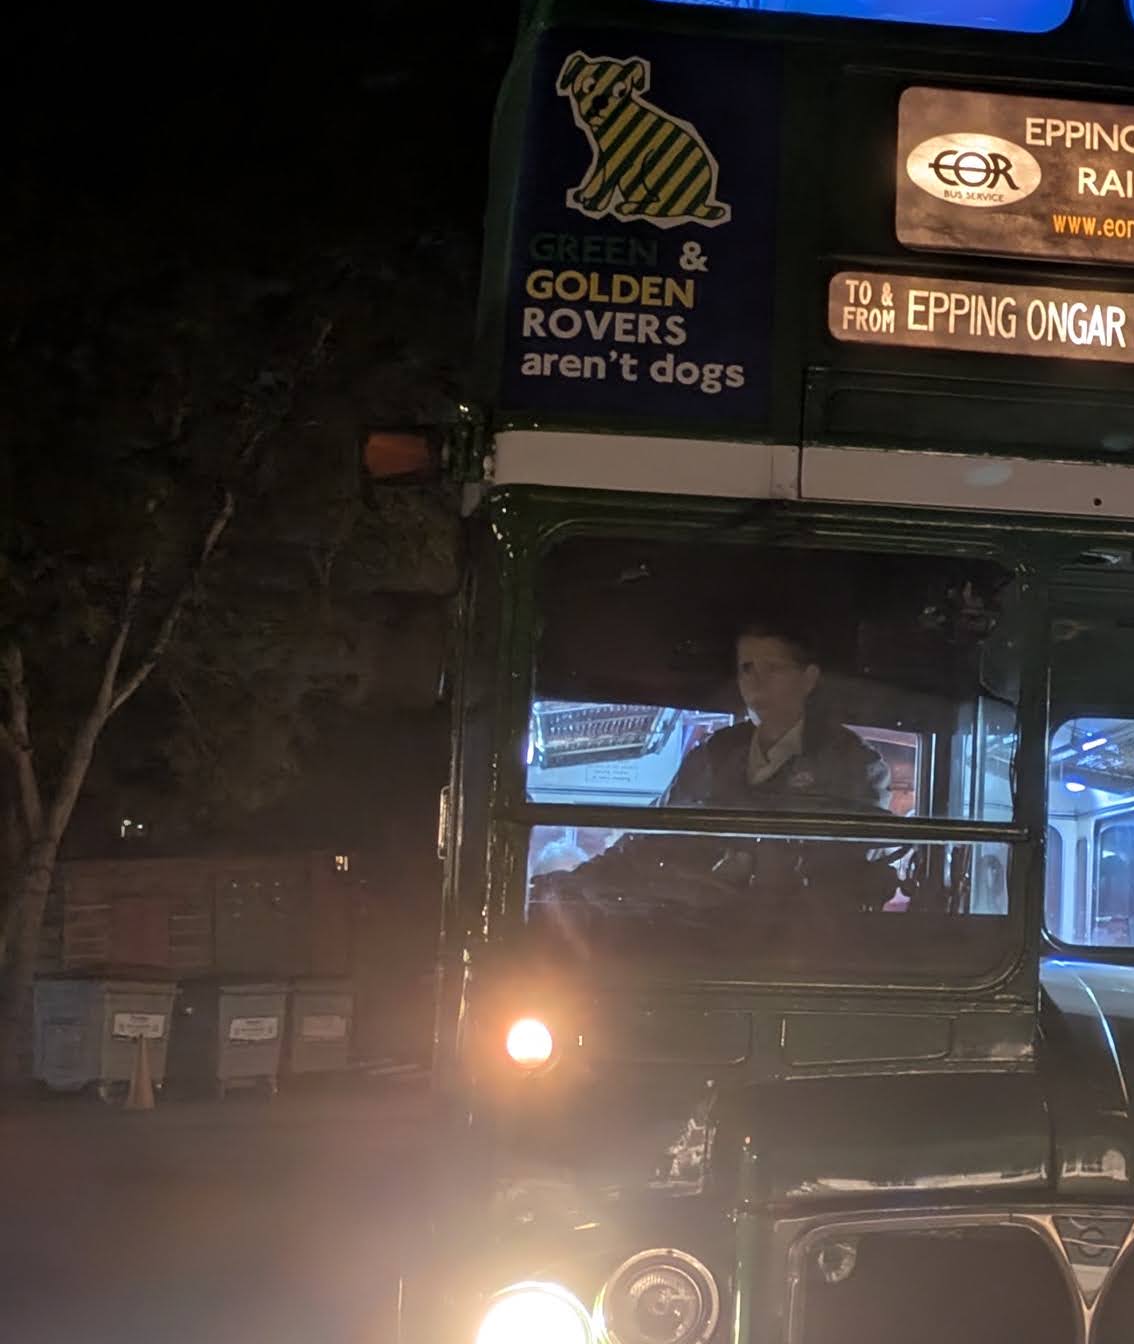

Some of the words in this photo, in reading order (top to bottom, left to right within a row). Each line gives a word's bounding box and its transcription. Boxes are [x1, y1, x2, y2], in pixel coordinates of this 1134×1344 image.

[928, 149, 1020, 191] EOR
[944, 189, 964, 199] BUS
[966, 191, 1005, 203] SERVICE
[529, 233, 659, 266] GREEN
[678, 240, 710, 272] &
[525, 269, 696, 308] GOLDEN
[846, 280, 872, 305] TO
[881, 283, 894, 305] &
[522, 307, 687, 346] ROVERS
[843, 306, 895, 333] FROM
[907, 290, 1017, 338] EPPING
[1026, 299, 1125, 347] ONGAR
[520, 349, 639, 382] aren't
[650, 353, 745, 394] dogs
